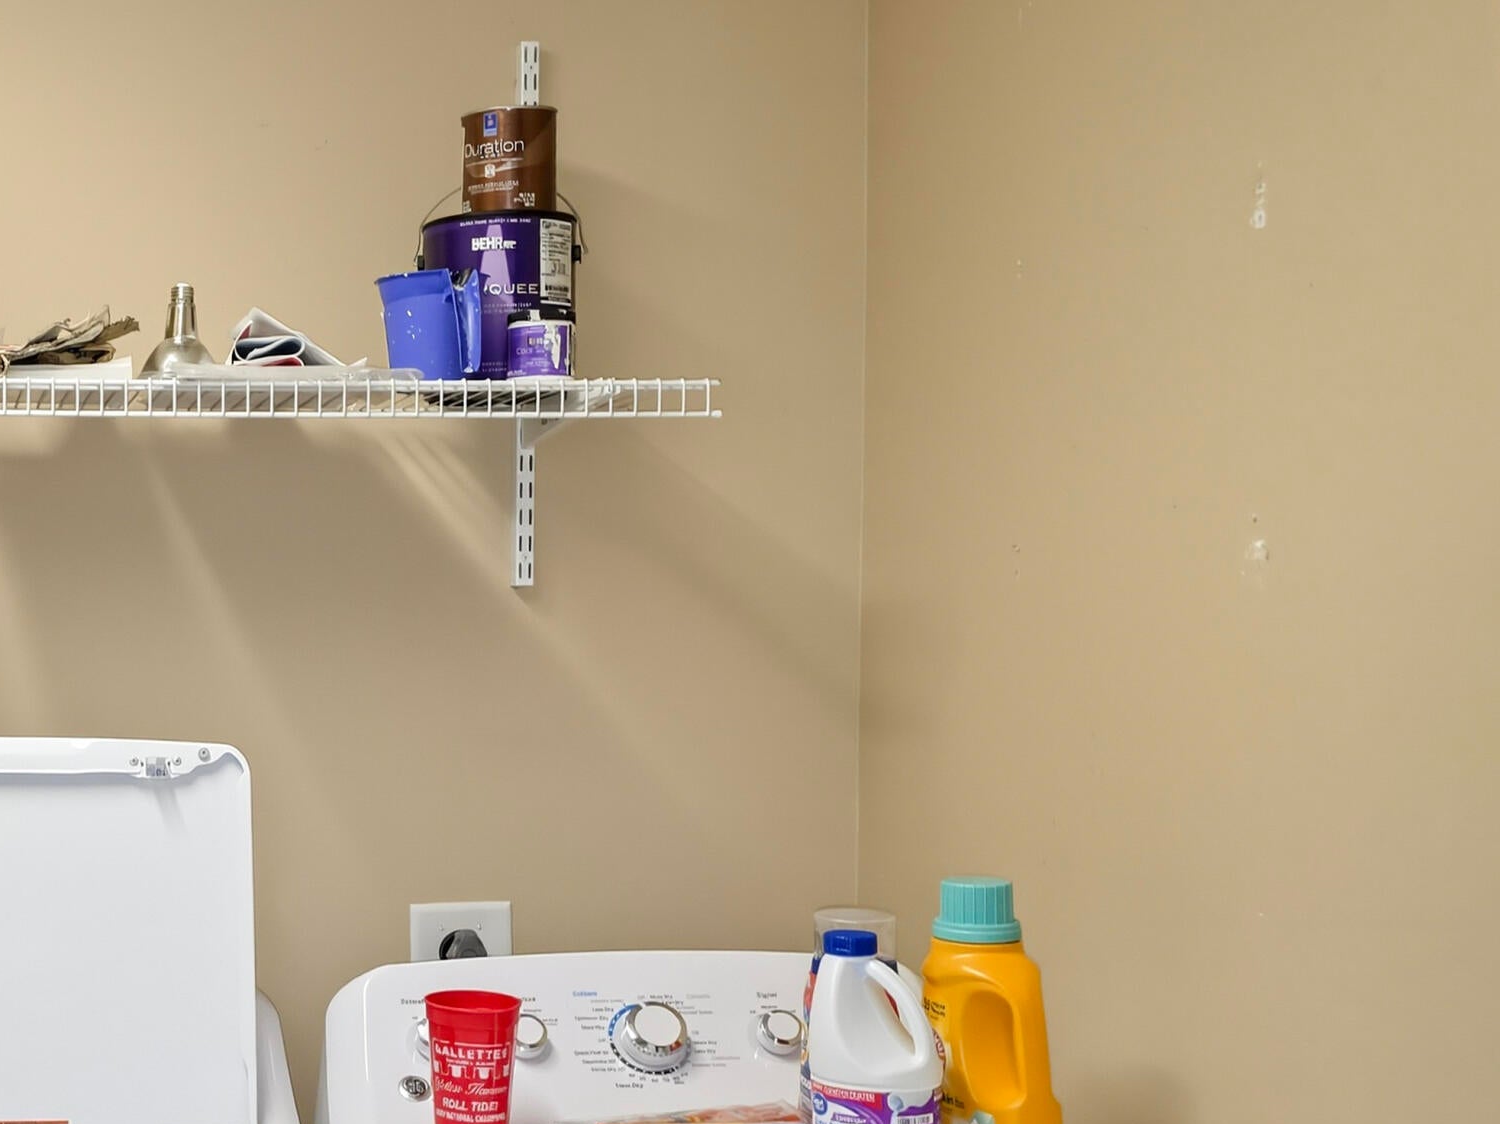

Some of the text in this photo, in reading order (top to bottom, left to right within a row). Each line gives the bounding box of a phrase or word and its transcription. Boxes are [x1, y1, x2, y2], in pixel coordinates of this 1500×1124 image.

[465, 138, 525, 158] Duration
[471, 236, 502, 252] BEHR
[442, 1097, 468, 1112] ROLL
